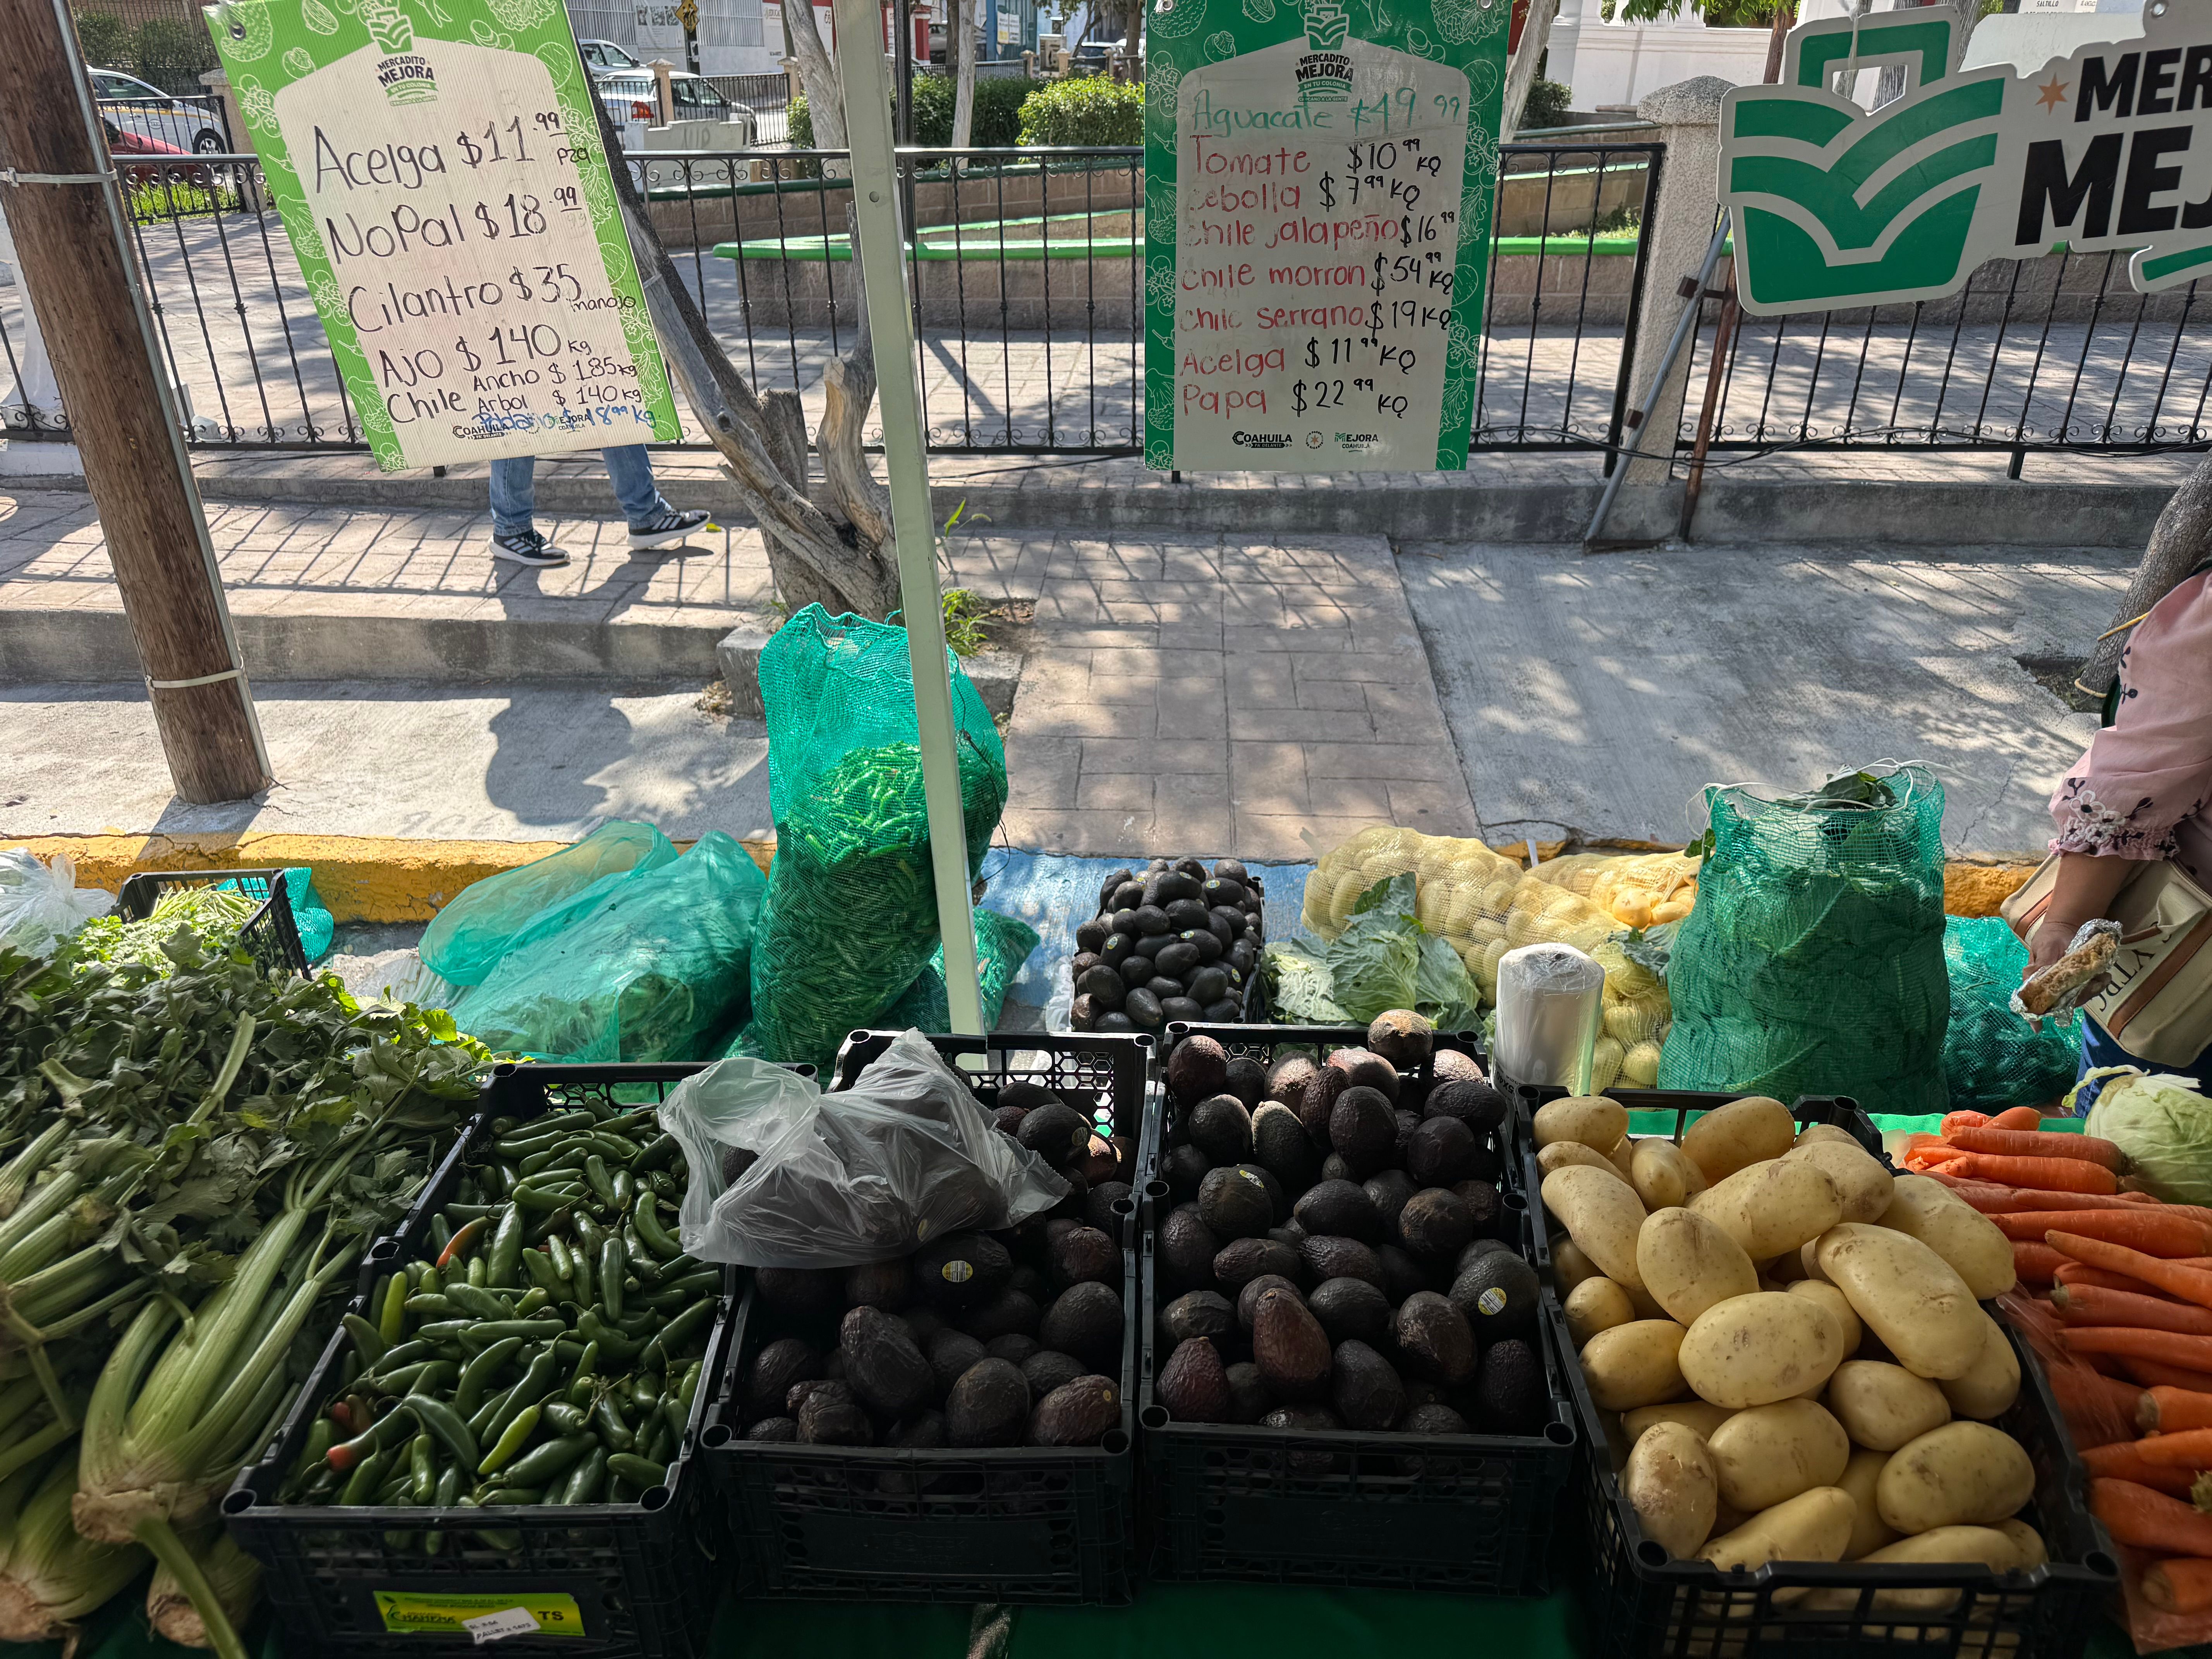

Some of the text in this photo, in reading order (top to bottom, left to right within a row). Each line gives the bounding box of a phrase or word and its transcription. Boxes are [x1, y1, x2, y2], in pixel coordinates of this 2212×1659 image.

[377, 56, 425, 72] MERCADITO
[1299, 53, 1350, 66] MERCADITO
[378, 65, 435, 88] MEJORA
[1295, 63, 1354, 82] MEJORA
[1191, 89, 1333, 137] Aguacate
[314, 125, 446, 194] Acelga
[1190, 135, 1310, 175] Tomate
[1265, 214, 1398, 251] jalapeño
[1269, 264, 1365, 289] morron
[347, 275, 503, 333] Cilantro
[1257, 304, 1363, 330] serrano
[1180, 347, 1285, 377] Acelga
[474, 369, 540, 392] Ancho
[387, 388, 467, 423] Chile
[478, 394, 529, 413] Arbol
[1183, 383, 1268, 419] Papa
[1232, 431, 1293, 445] COAHUILA
[1334, 432, 1378, 442] MEJORA
[538, 1611, 564, 1621] TS
[476, 1628, 504, 1639] PALLET
